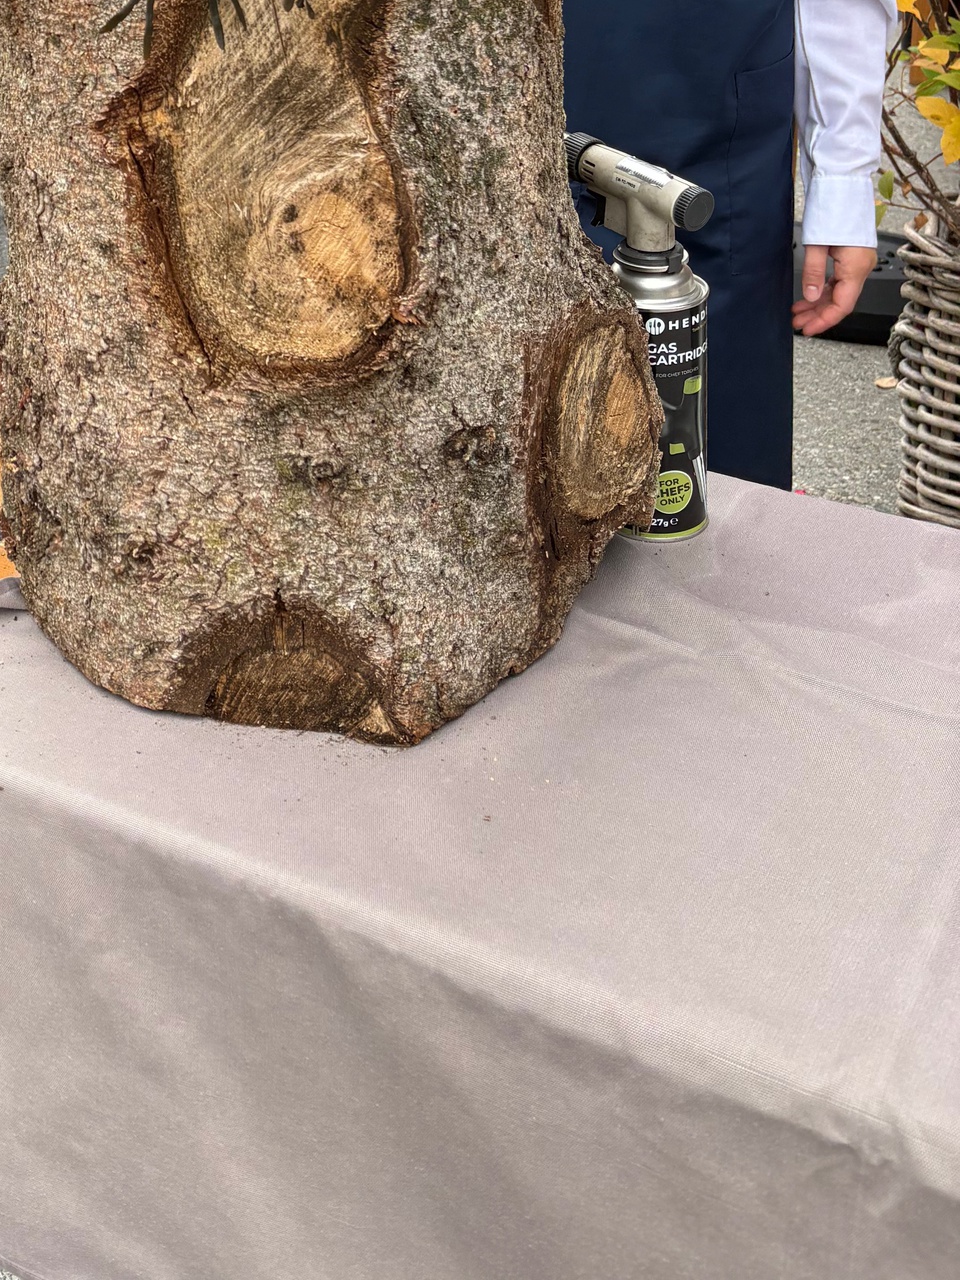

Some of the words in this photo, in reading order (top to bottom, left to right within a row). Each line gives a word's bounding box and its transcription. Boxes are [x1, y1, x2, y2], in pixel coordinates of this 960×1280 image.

[668, 306, 707, 330] HEND
[648, 342, 678, 354] GAS
[648, 341, 707, 366] CARTRIDG
[656, 482, 691, 498] HEFS
[659, 478, 679, 488] FOR
[659, 494, 685, 506] ONLY
